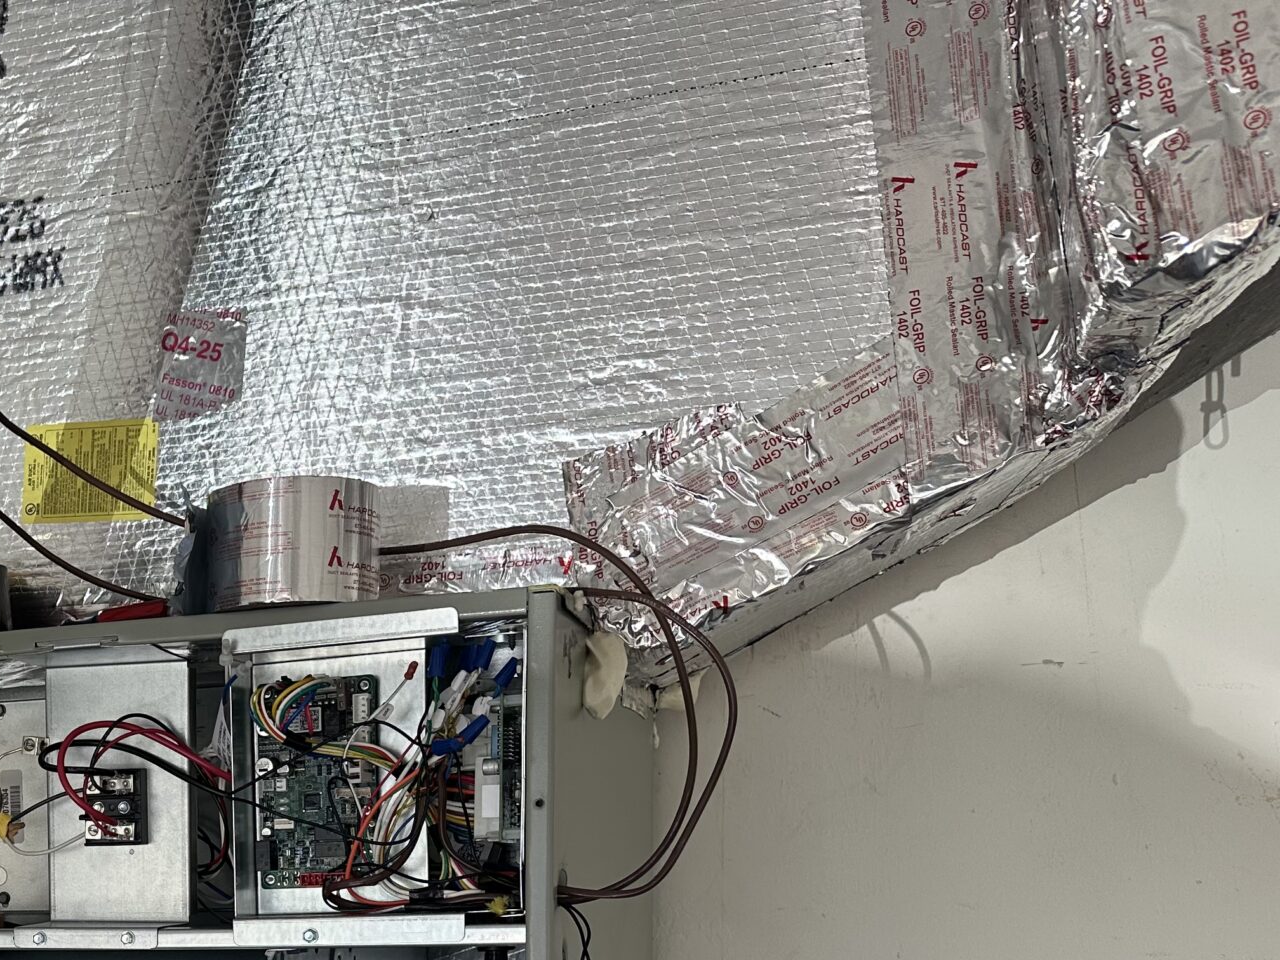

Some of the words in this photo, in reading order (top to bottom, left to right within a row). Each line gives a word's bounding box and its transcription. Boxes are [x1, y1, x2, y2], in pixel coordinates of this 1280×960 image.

[1217, 40, 1235, 75] 1402
[1232, 10, 1260, 91] FOIL-GRIP
[1135, 65, 1155, 99] 1402
[1150, 35, 1176, 115] FOIL-GRIP
[891, 197, 909, 275] HARDCAST
[954, 183, 972, 262] HARDCAST
[946, 276, 955, 301] Rolled
[1007, 265, 1015, 290] Rolled
[166, 312, 216, 333] MH14352
[909, 289, 926, 353] FOIL-GRIP
[948, 301, 958, 326] Mastic
[959, 298, 972, 326] 1402
[972, 276, 989, 341] FOIL-GRIP
[896, 311, 909, 339] 1402
[161, 331, 224, 362] Q4-25
[951, 327, 960, 356] Sealant
[160, 389, 174, 402] UL
[208, 384, 235, 399] 0810
[819, 372, 900, 421] HARDCAST
[155, 404, 169, 417] UL
[775, 475, 841, 516] FOIL-GRIP
[786, 475, 817, 496] 1402
[420, 558, 445, 572] 1402
